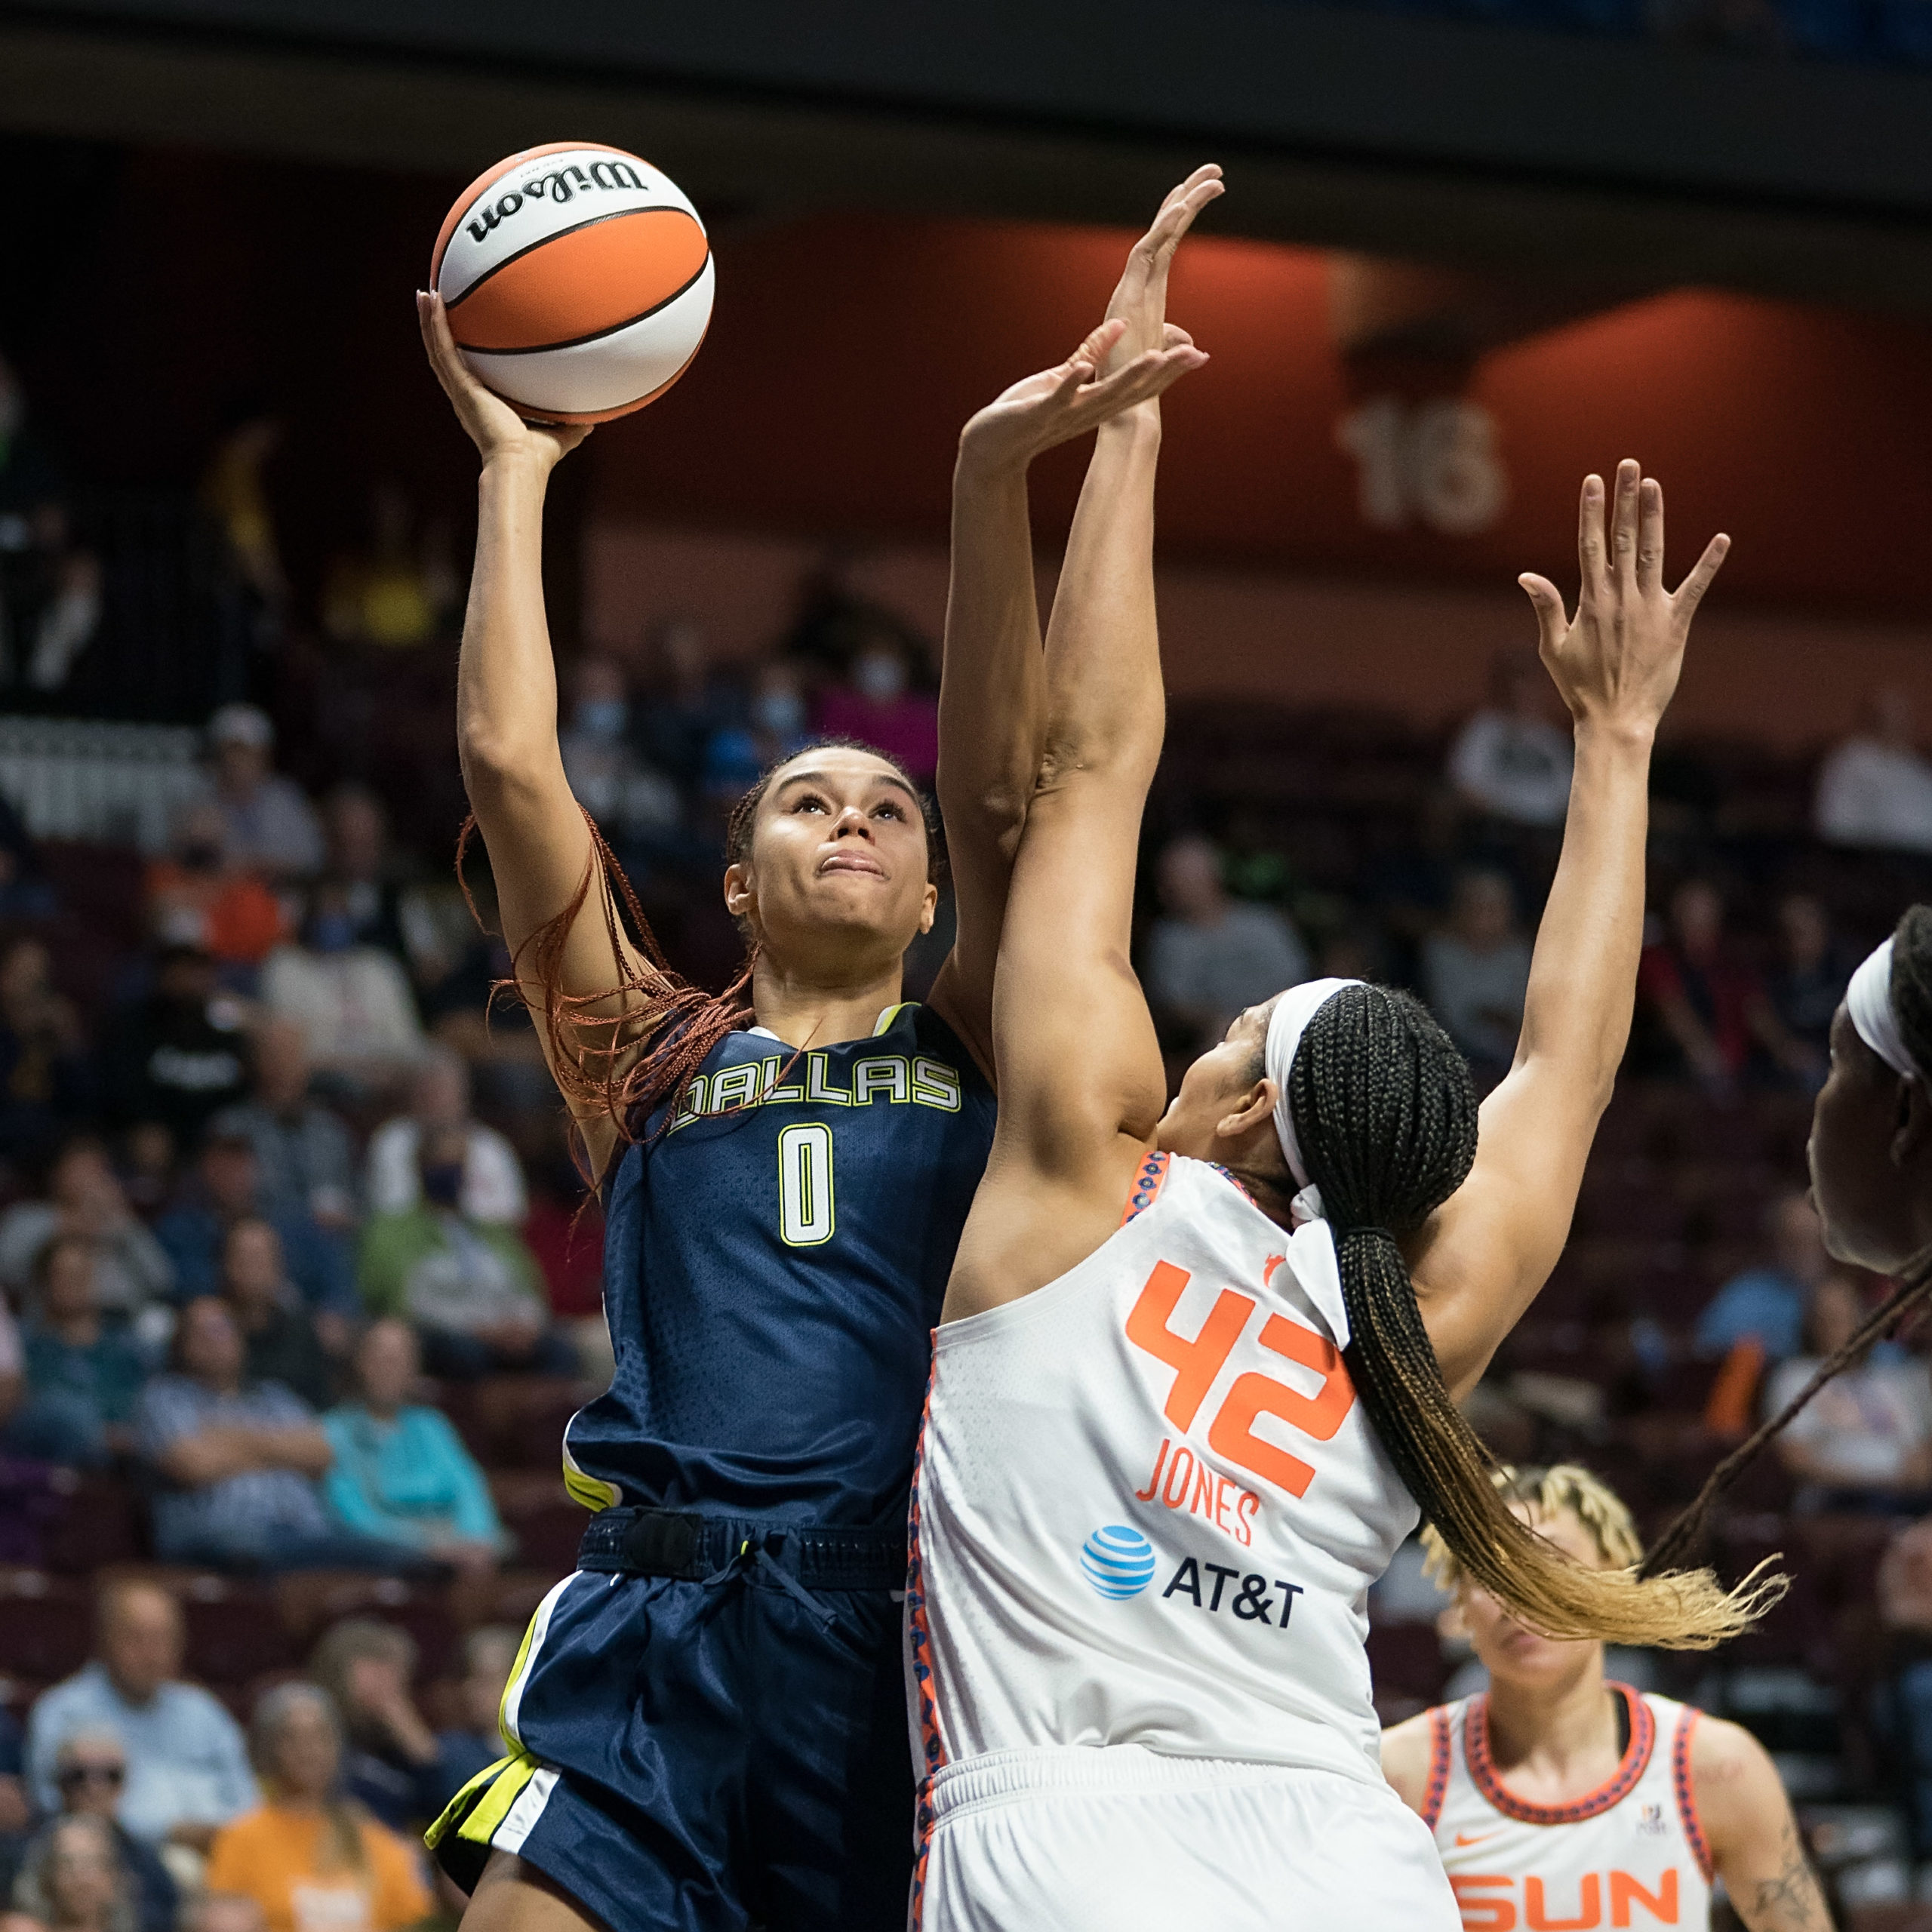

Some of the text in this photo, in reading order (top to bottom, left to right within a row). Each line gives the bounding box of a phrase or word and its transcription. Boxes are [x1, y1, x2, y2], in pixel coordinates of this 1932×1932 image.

[465, 161, 649, 243] Wilson
[667, 1052, 961, 1136] DALLAS
[778, 1121, 835, 1247] 0
[1124, 1259, 1358, 1499] 42
[1135, 1438, 1260, 1547] JONES
[1162, 1557, 1304, 1629] AT&T
[1448, 1867, 1678, 1932] SUN
